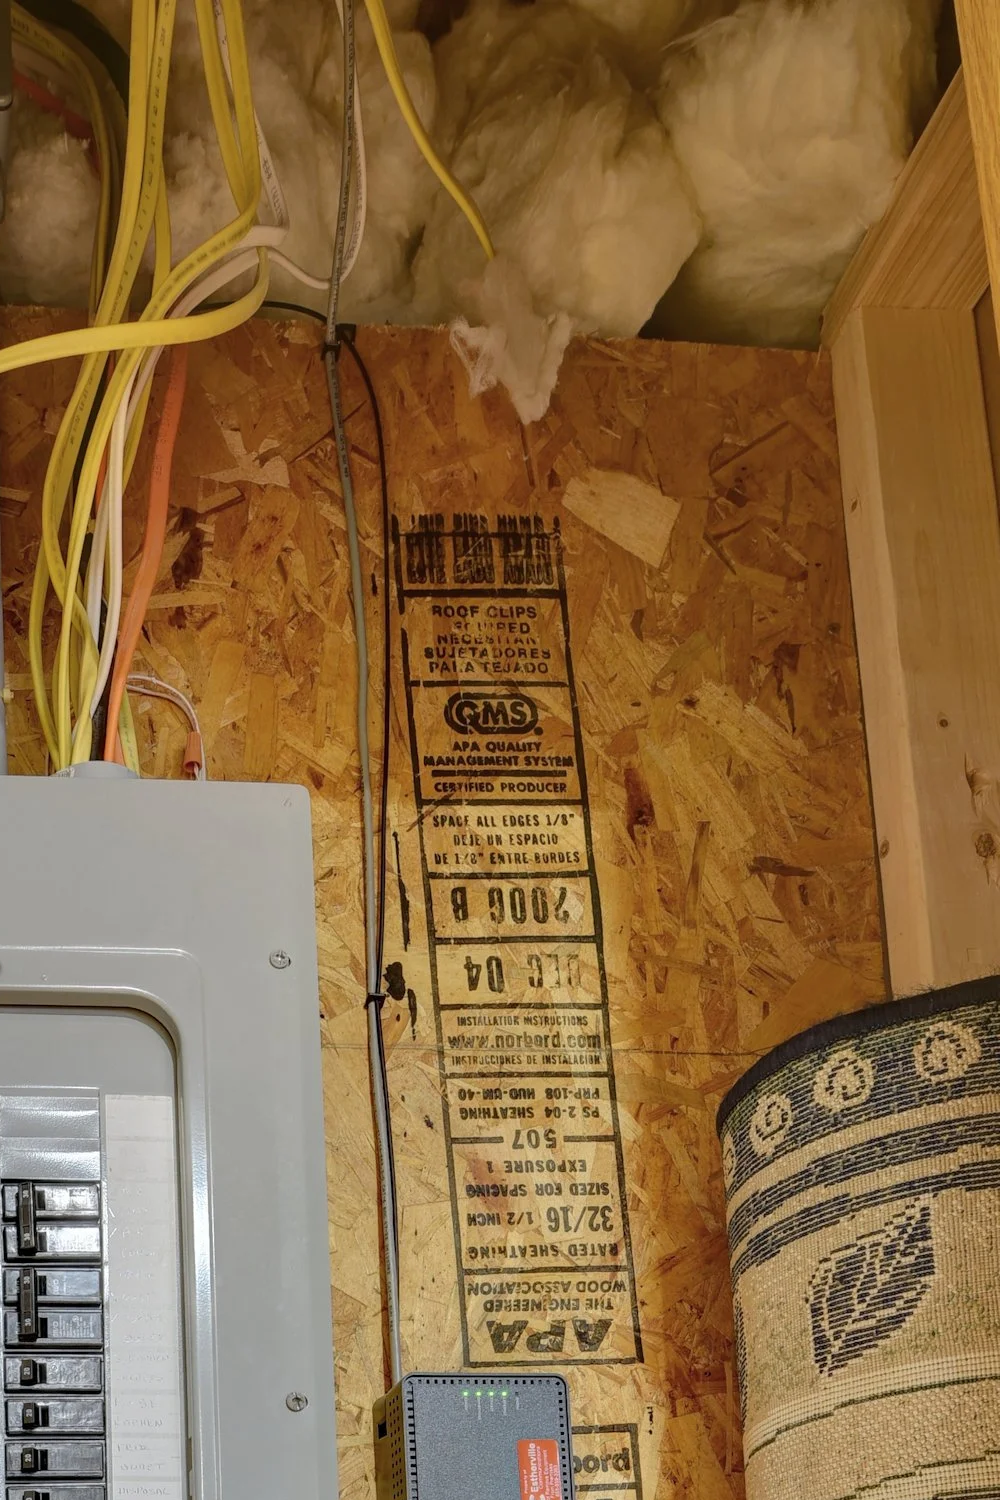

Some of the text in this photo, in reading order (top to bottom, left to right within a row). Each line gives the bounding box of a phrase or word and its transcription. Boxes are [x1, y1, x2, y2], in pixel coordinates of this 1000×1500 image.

[450, 697, 533, 730] QMS
[452, 741, 542, 753] APA QUALITY
[423, 755, 574, 767] MANAGEMENT SYSTEM
[434, 782, 567, 793] CERTIFIED PRODUCER
[477, 815, 496, 827] ALL
[503, 815, 540, 827] EDGES
[546, 814, 574, 827] 1/8"
[453, 834, 481, 846] DEJE
[510, 834, 558, 845] ESPACIO
[434, 853, 449, 865] DE
[490, 853, 529, 864] ENTRE
[535, 852, 580, 864] BORDES
[464, 955, 504, 994] 04
[457, 1015, 588, 1026] INSTALLATION INSTRUCTIONS
[448, 1031, 600, 1049] www.norbord.com
[544, 1087, 600, 1100] PRP-108
[460, 1106, 600, 1120] PS 2-04 SHEATHING
[511, 1129, 557, 1149] 507
[487, 1160, 587, 1173] EXPOSURE 1
[465, 1183, 610, 1197] SIZED FOR SPACING
[467, 1205, 614, 1233] 32/16 1/2 INCH
[468, 1243, 618, 1259] RATED SHEATHING
[467, 1281, 627, 1296] WOOD ASSOCIATION
[483, 1298, 614, 1313] THE ENGINEERED
[486, 1319, 614, 1354] APA
